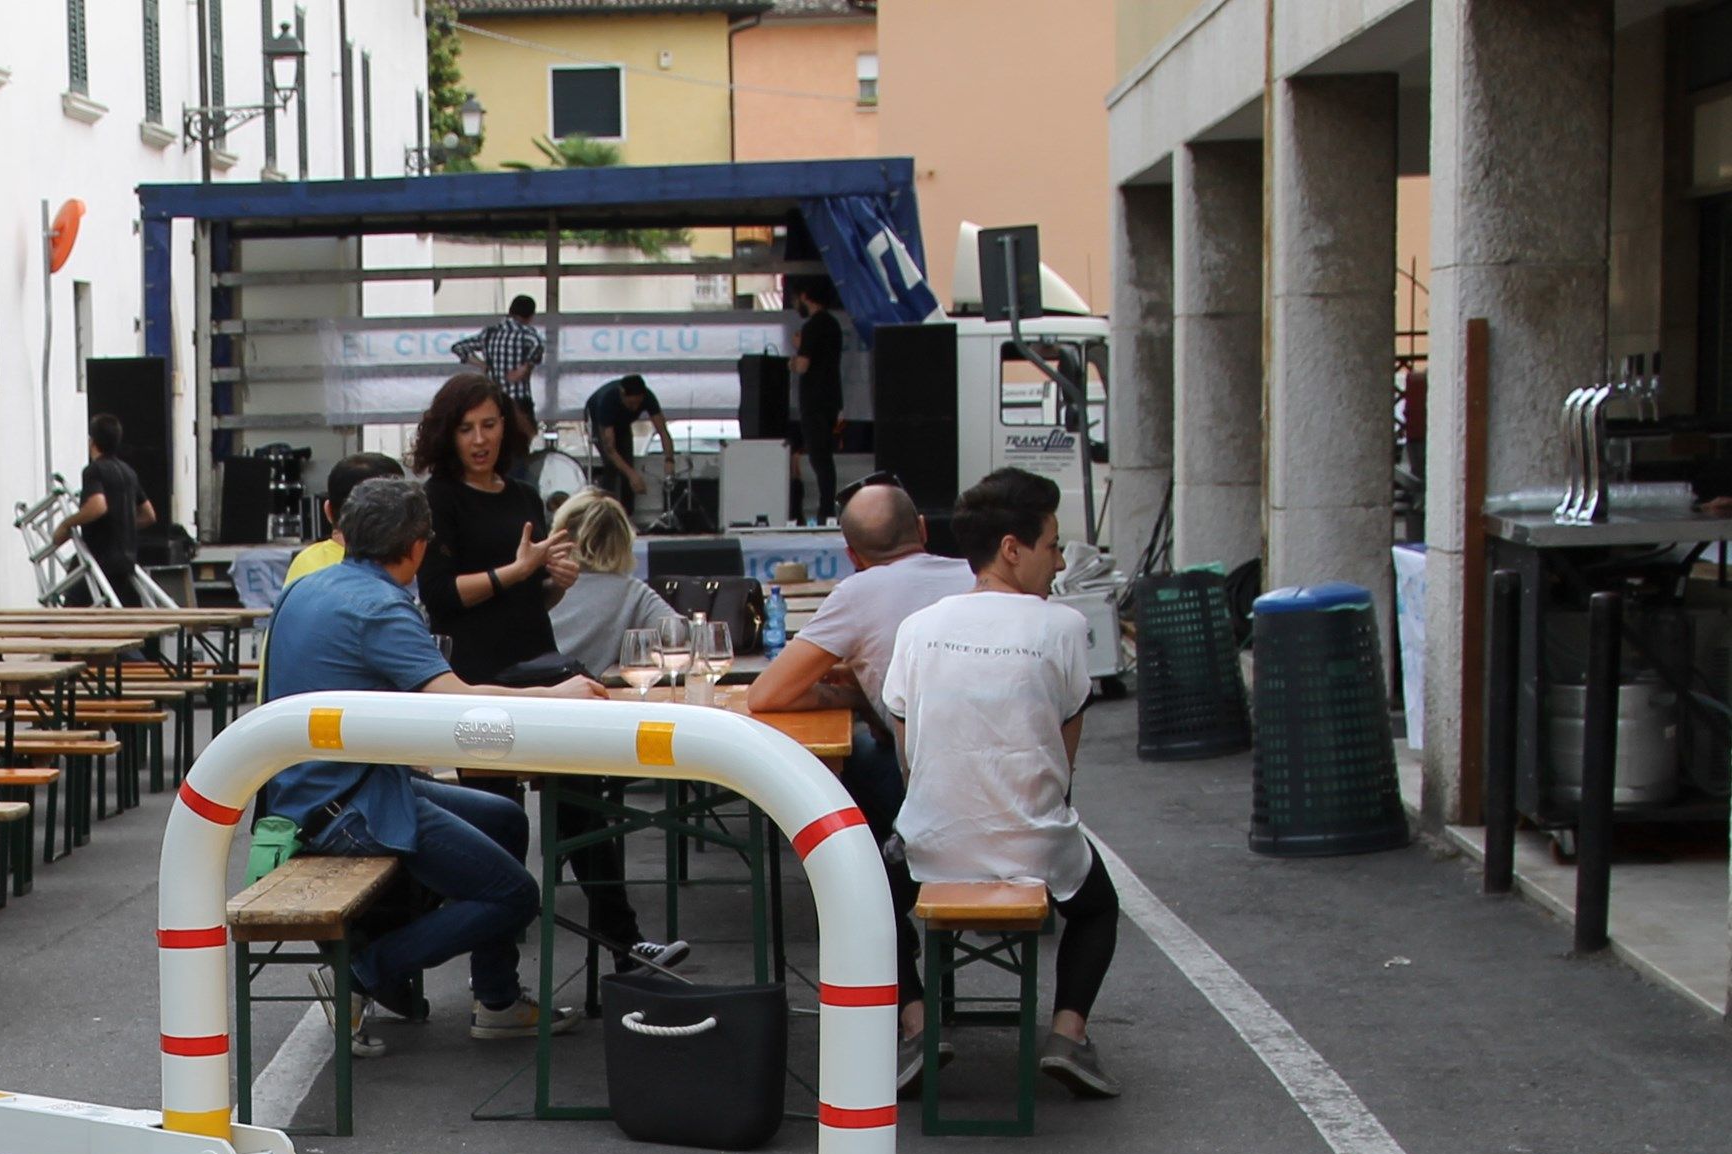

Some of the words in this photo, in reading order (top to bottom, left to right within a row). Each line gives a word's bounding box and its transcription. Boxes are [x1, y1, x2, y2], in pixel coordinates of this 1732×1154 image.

[943, 642, 970, 653] NICE
[974, 646, 990, 655] OR
[994, 648, 1010, 656] GO
[1015, 648, 1044, 659] AWAY
